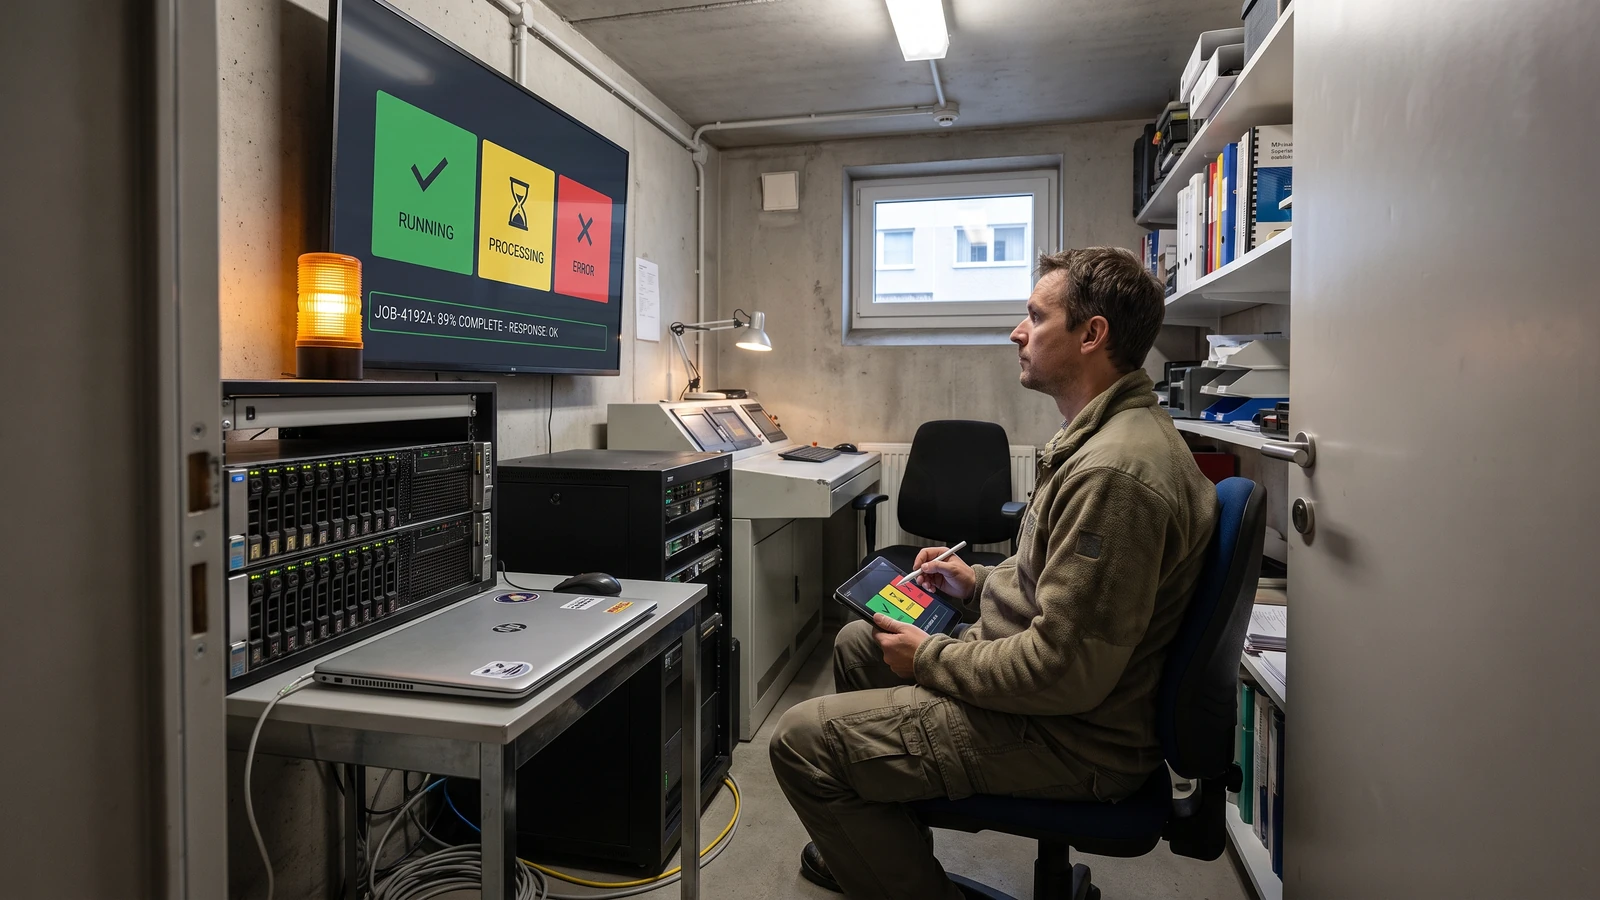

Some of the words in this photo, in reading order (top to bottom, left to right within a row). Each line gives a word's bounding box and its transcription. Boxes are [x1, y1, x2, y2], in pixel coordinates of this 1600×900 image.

[399, 212, 454, 240] RUNNING
[489, 237, 544, 264] PROCESSING
[573, 260, 594, 277] ERROR
[375, 305, 435, 324] JOB-4192A:
[437, 312, 457, 327] 89%
[458, 315, 503, 332] COMPLETE
[548, 326, 559, 338] OK
